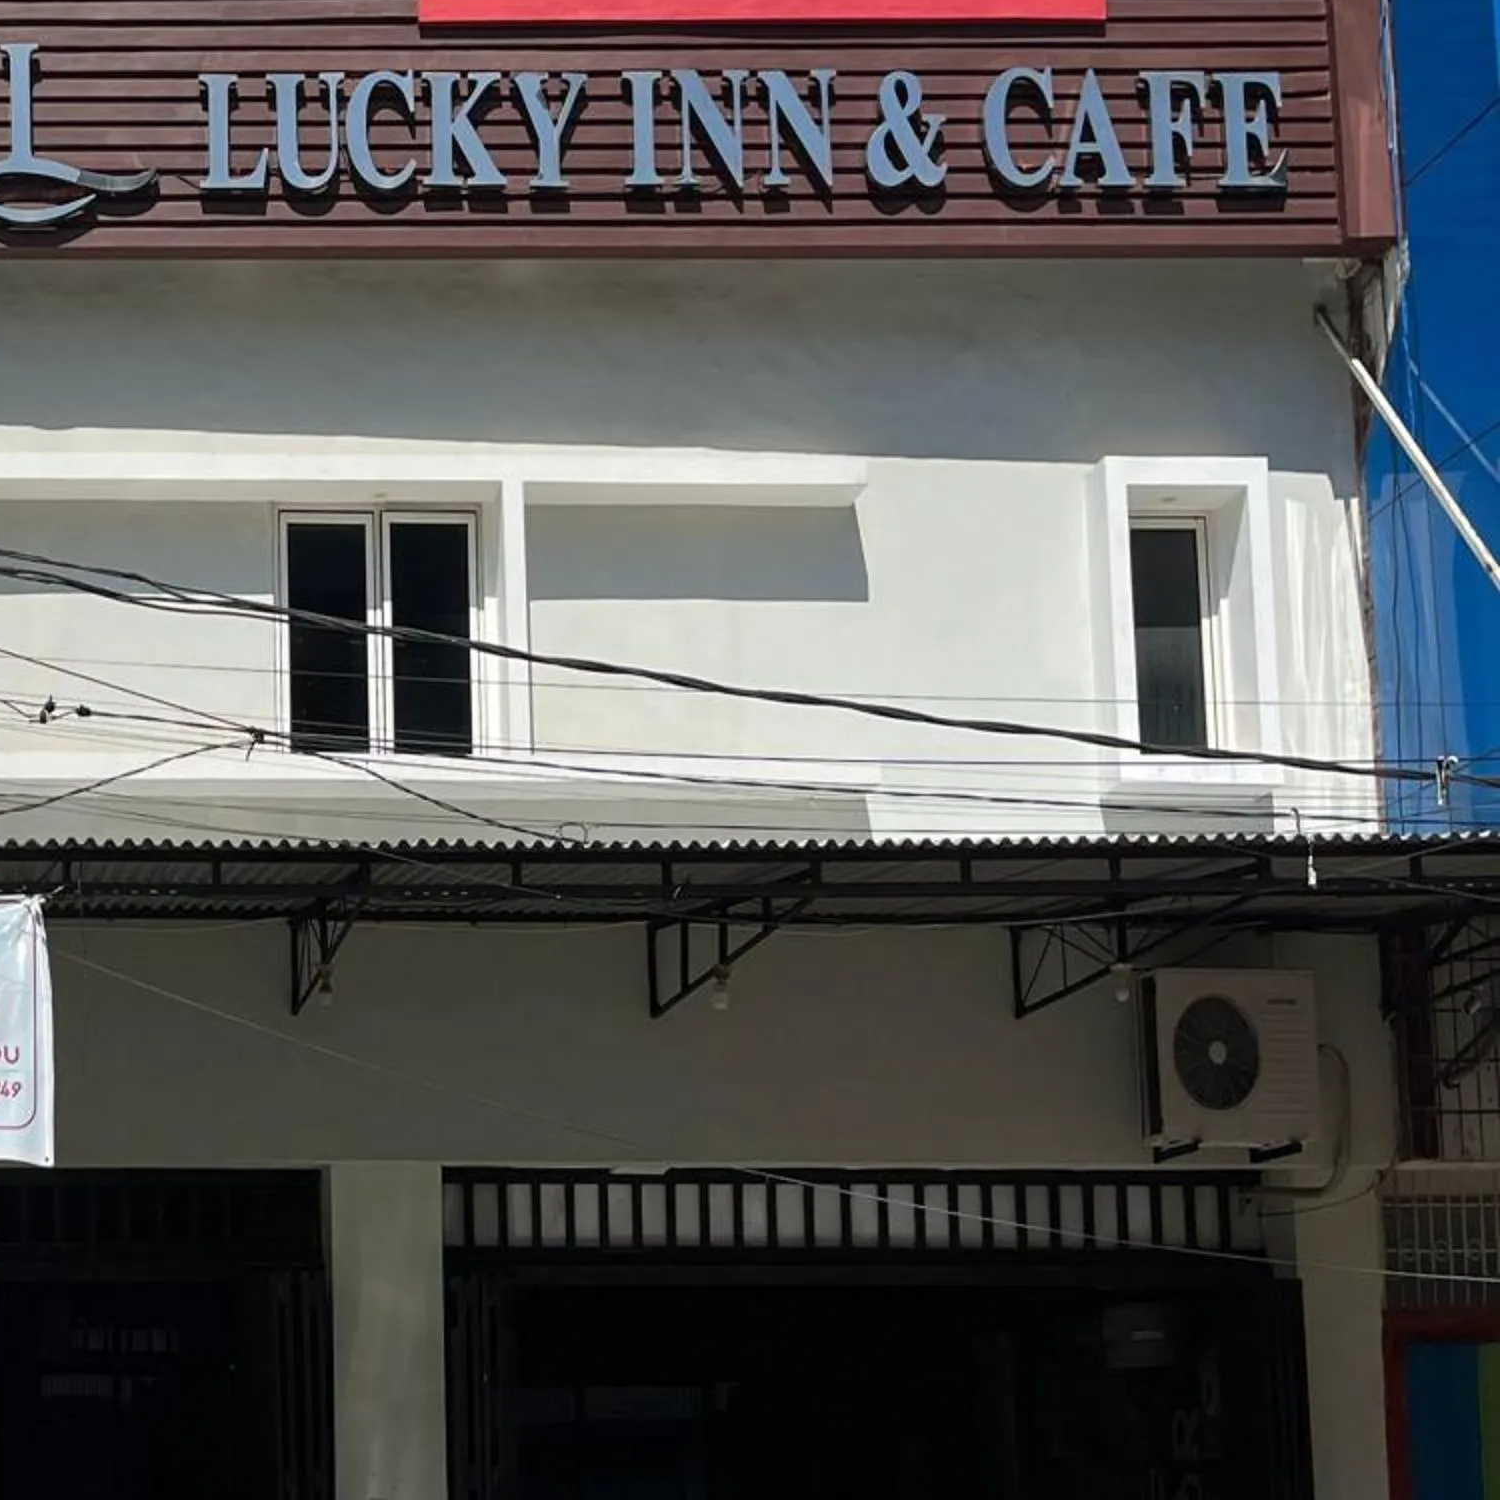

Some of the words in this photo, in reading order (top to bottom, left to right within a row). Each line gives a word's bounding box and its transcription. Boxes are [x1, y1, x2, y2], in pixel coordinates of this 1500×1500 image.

[199, 70, 588, 190] LUCKY
[621, 68, 836, 188] INN
[866, 70, 947, 188] &
[982, 66, 1287, 188] CAFE
